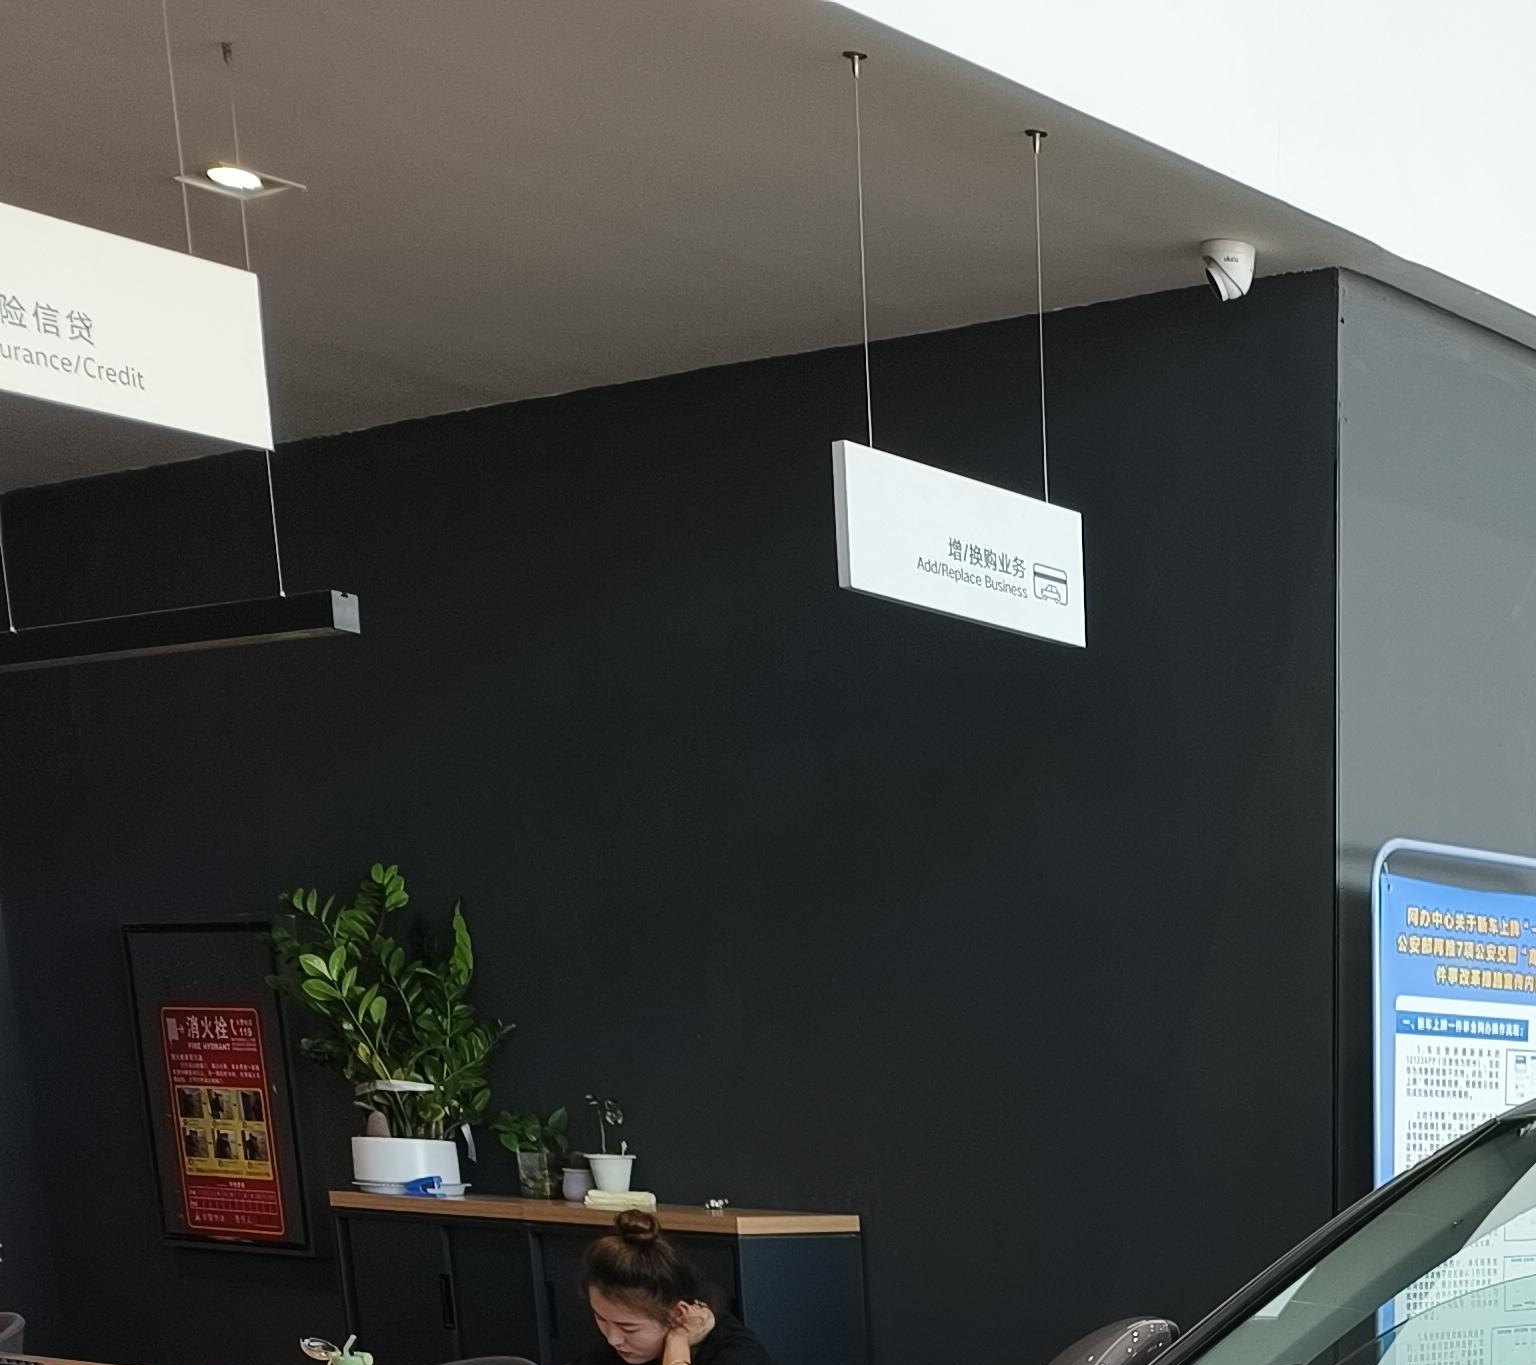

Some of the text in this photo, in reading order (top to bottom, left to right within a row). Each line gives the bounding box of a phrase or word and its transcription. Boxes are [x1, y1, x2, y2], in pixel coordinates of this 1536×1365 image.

[917, 557, 1028, 599] Add/Replace Business
[948, 537, 1027, 579] 增/换购业务
[186, 1015, 229, 1039] 消火栓
